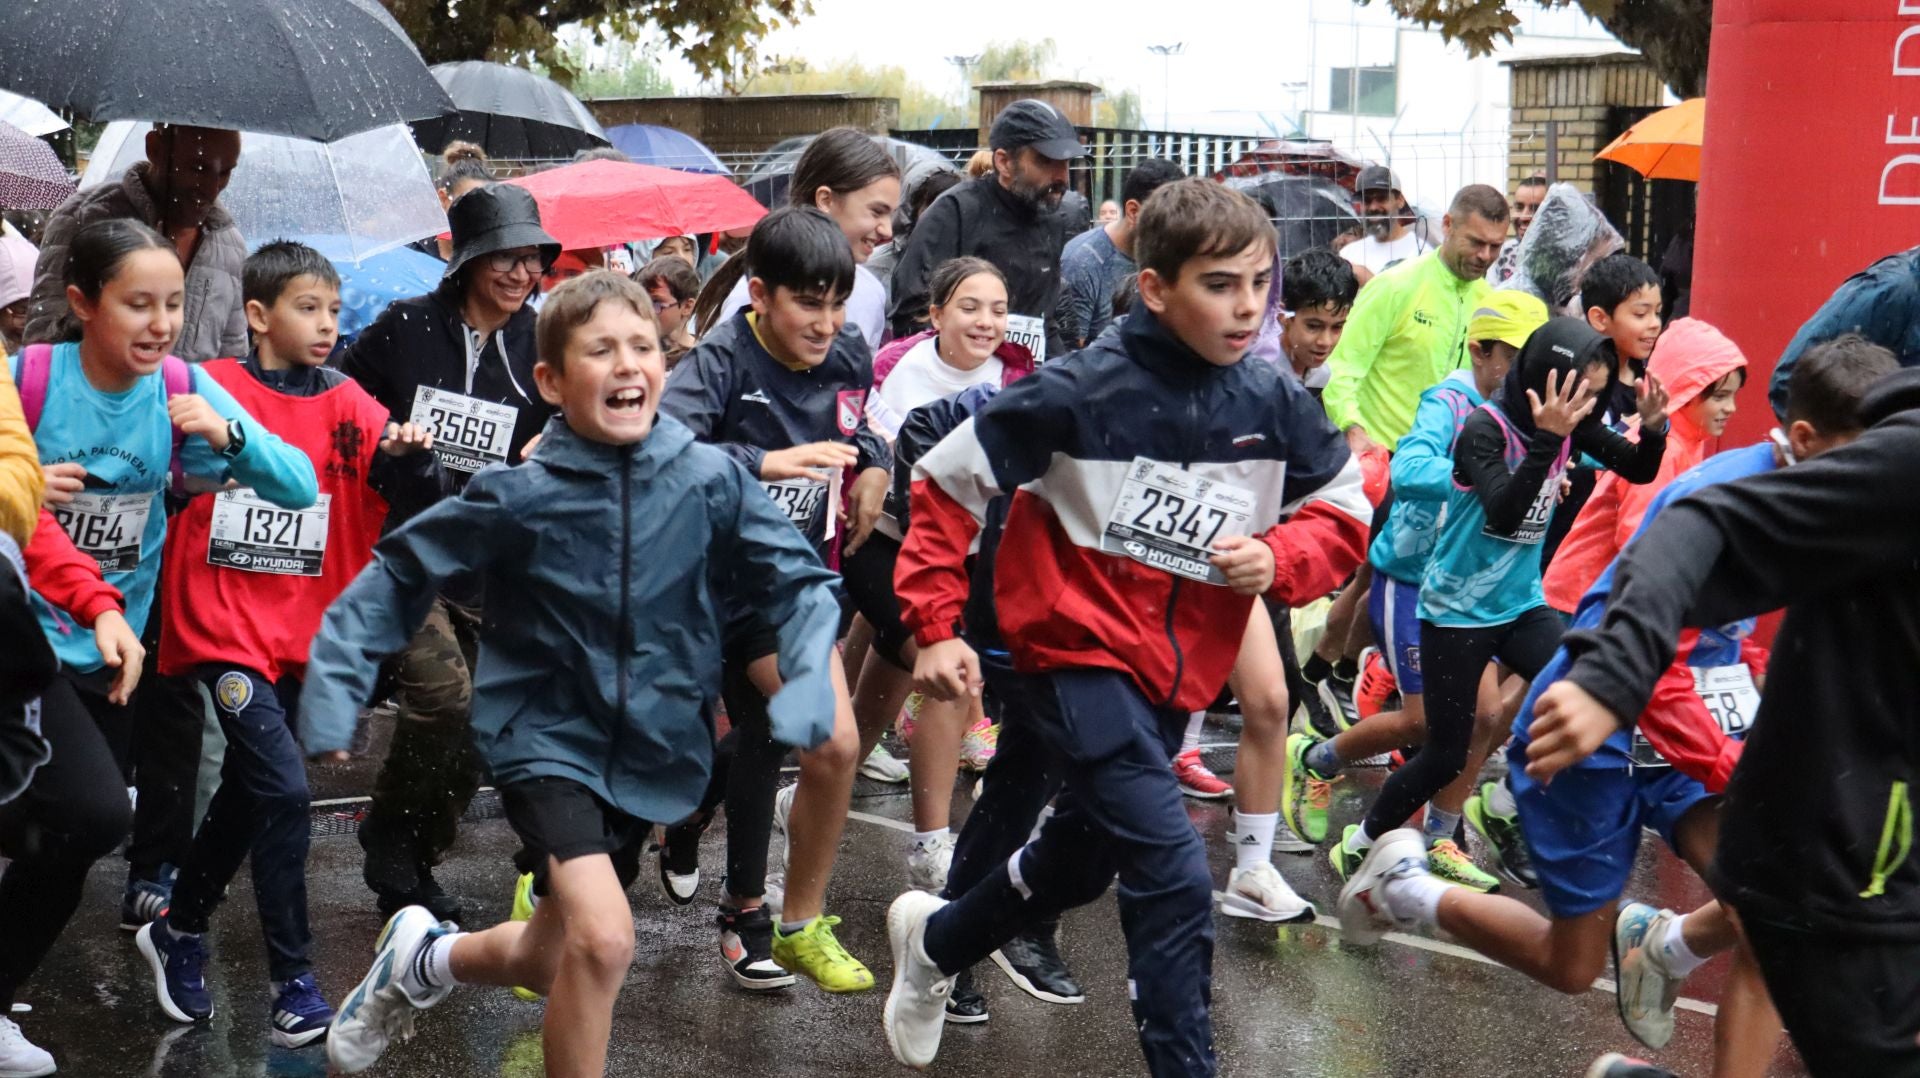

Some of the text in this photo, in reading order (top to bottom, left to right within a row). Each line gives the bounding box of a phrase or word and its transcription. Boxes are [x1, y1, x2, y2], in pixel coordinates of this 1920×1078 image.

[426, 407, 497, 451] 3569
[69, 449, 86, 460] LA
[91, 446, 148, 478] PALOMERA
[441, 452, 488, 469] HYUNDAI
[243, 507, 303, 547] 1321
[1132, 487, 1229, 549] 2347
[252, 556, 305, 570] HYUNDAI
[1146, 548, 1210, 576] HYUNDAI
